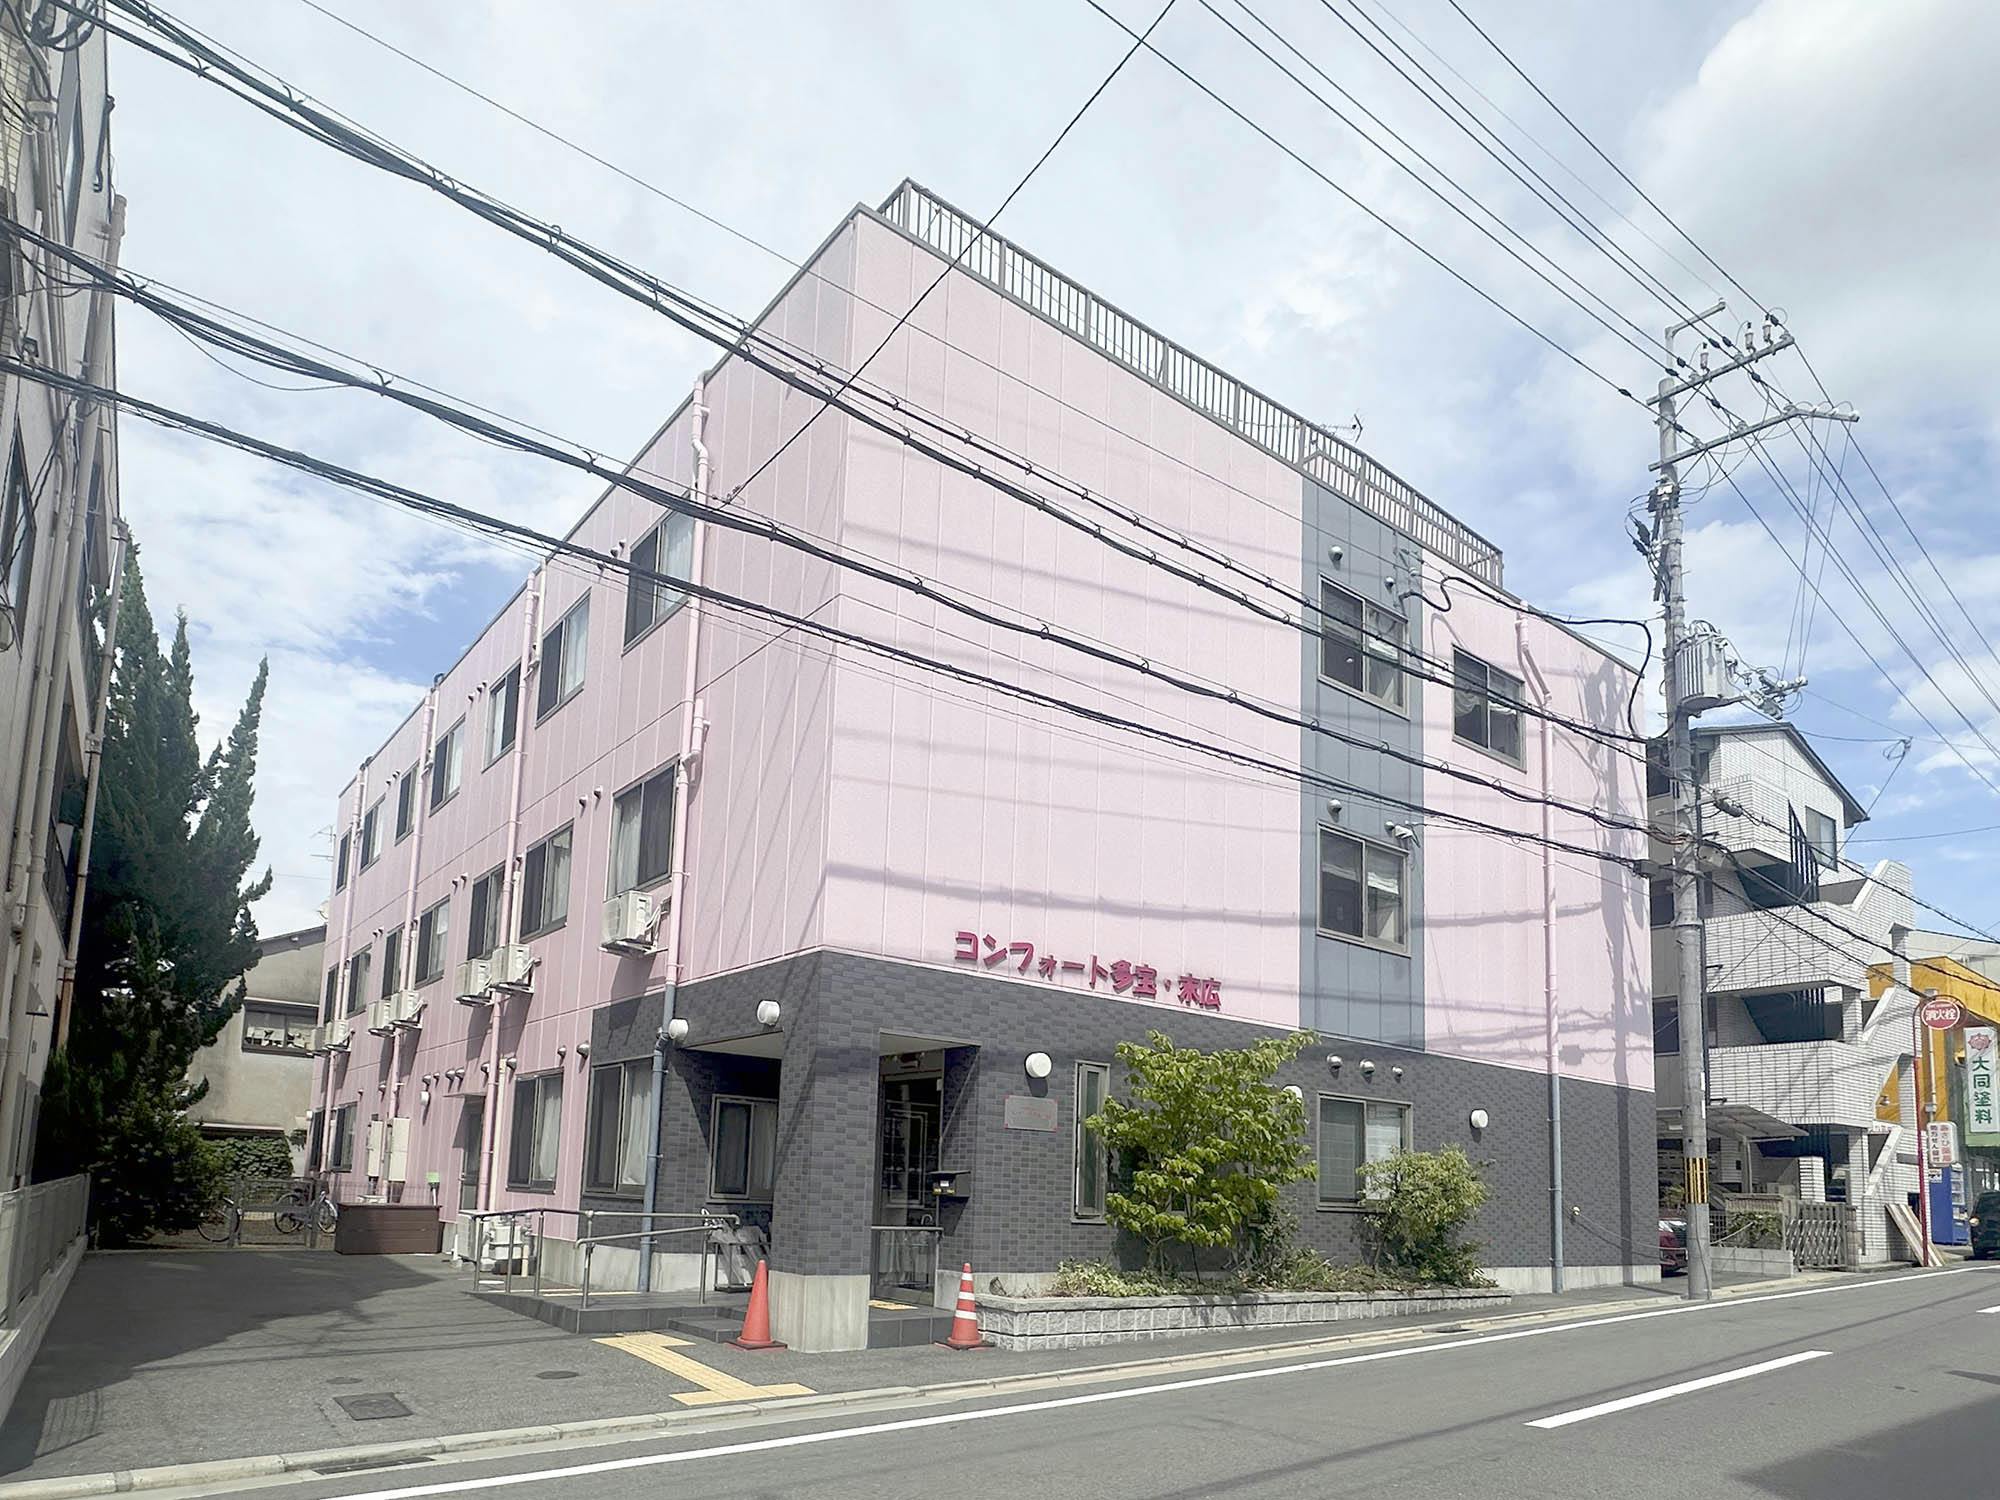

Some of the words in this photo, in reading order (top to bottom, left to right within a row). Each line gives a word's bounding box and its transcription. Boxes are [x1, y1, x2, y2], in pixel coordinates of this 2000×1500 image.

[954, 930, 1222, 1012] コンフォート多宝・末広
[1925, 1008, 1956, 1021] 消火栓
[1972, 1056, 1993, 1124] 大同塗料
